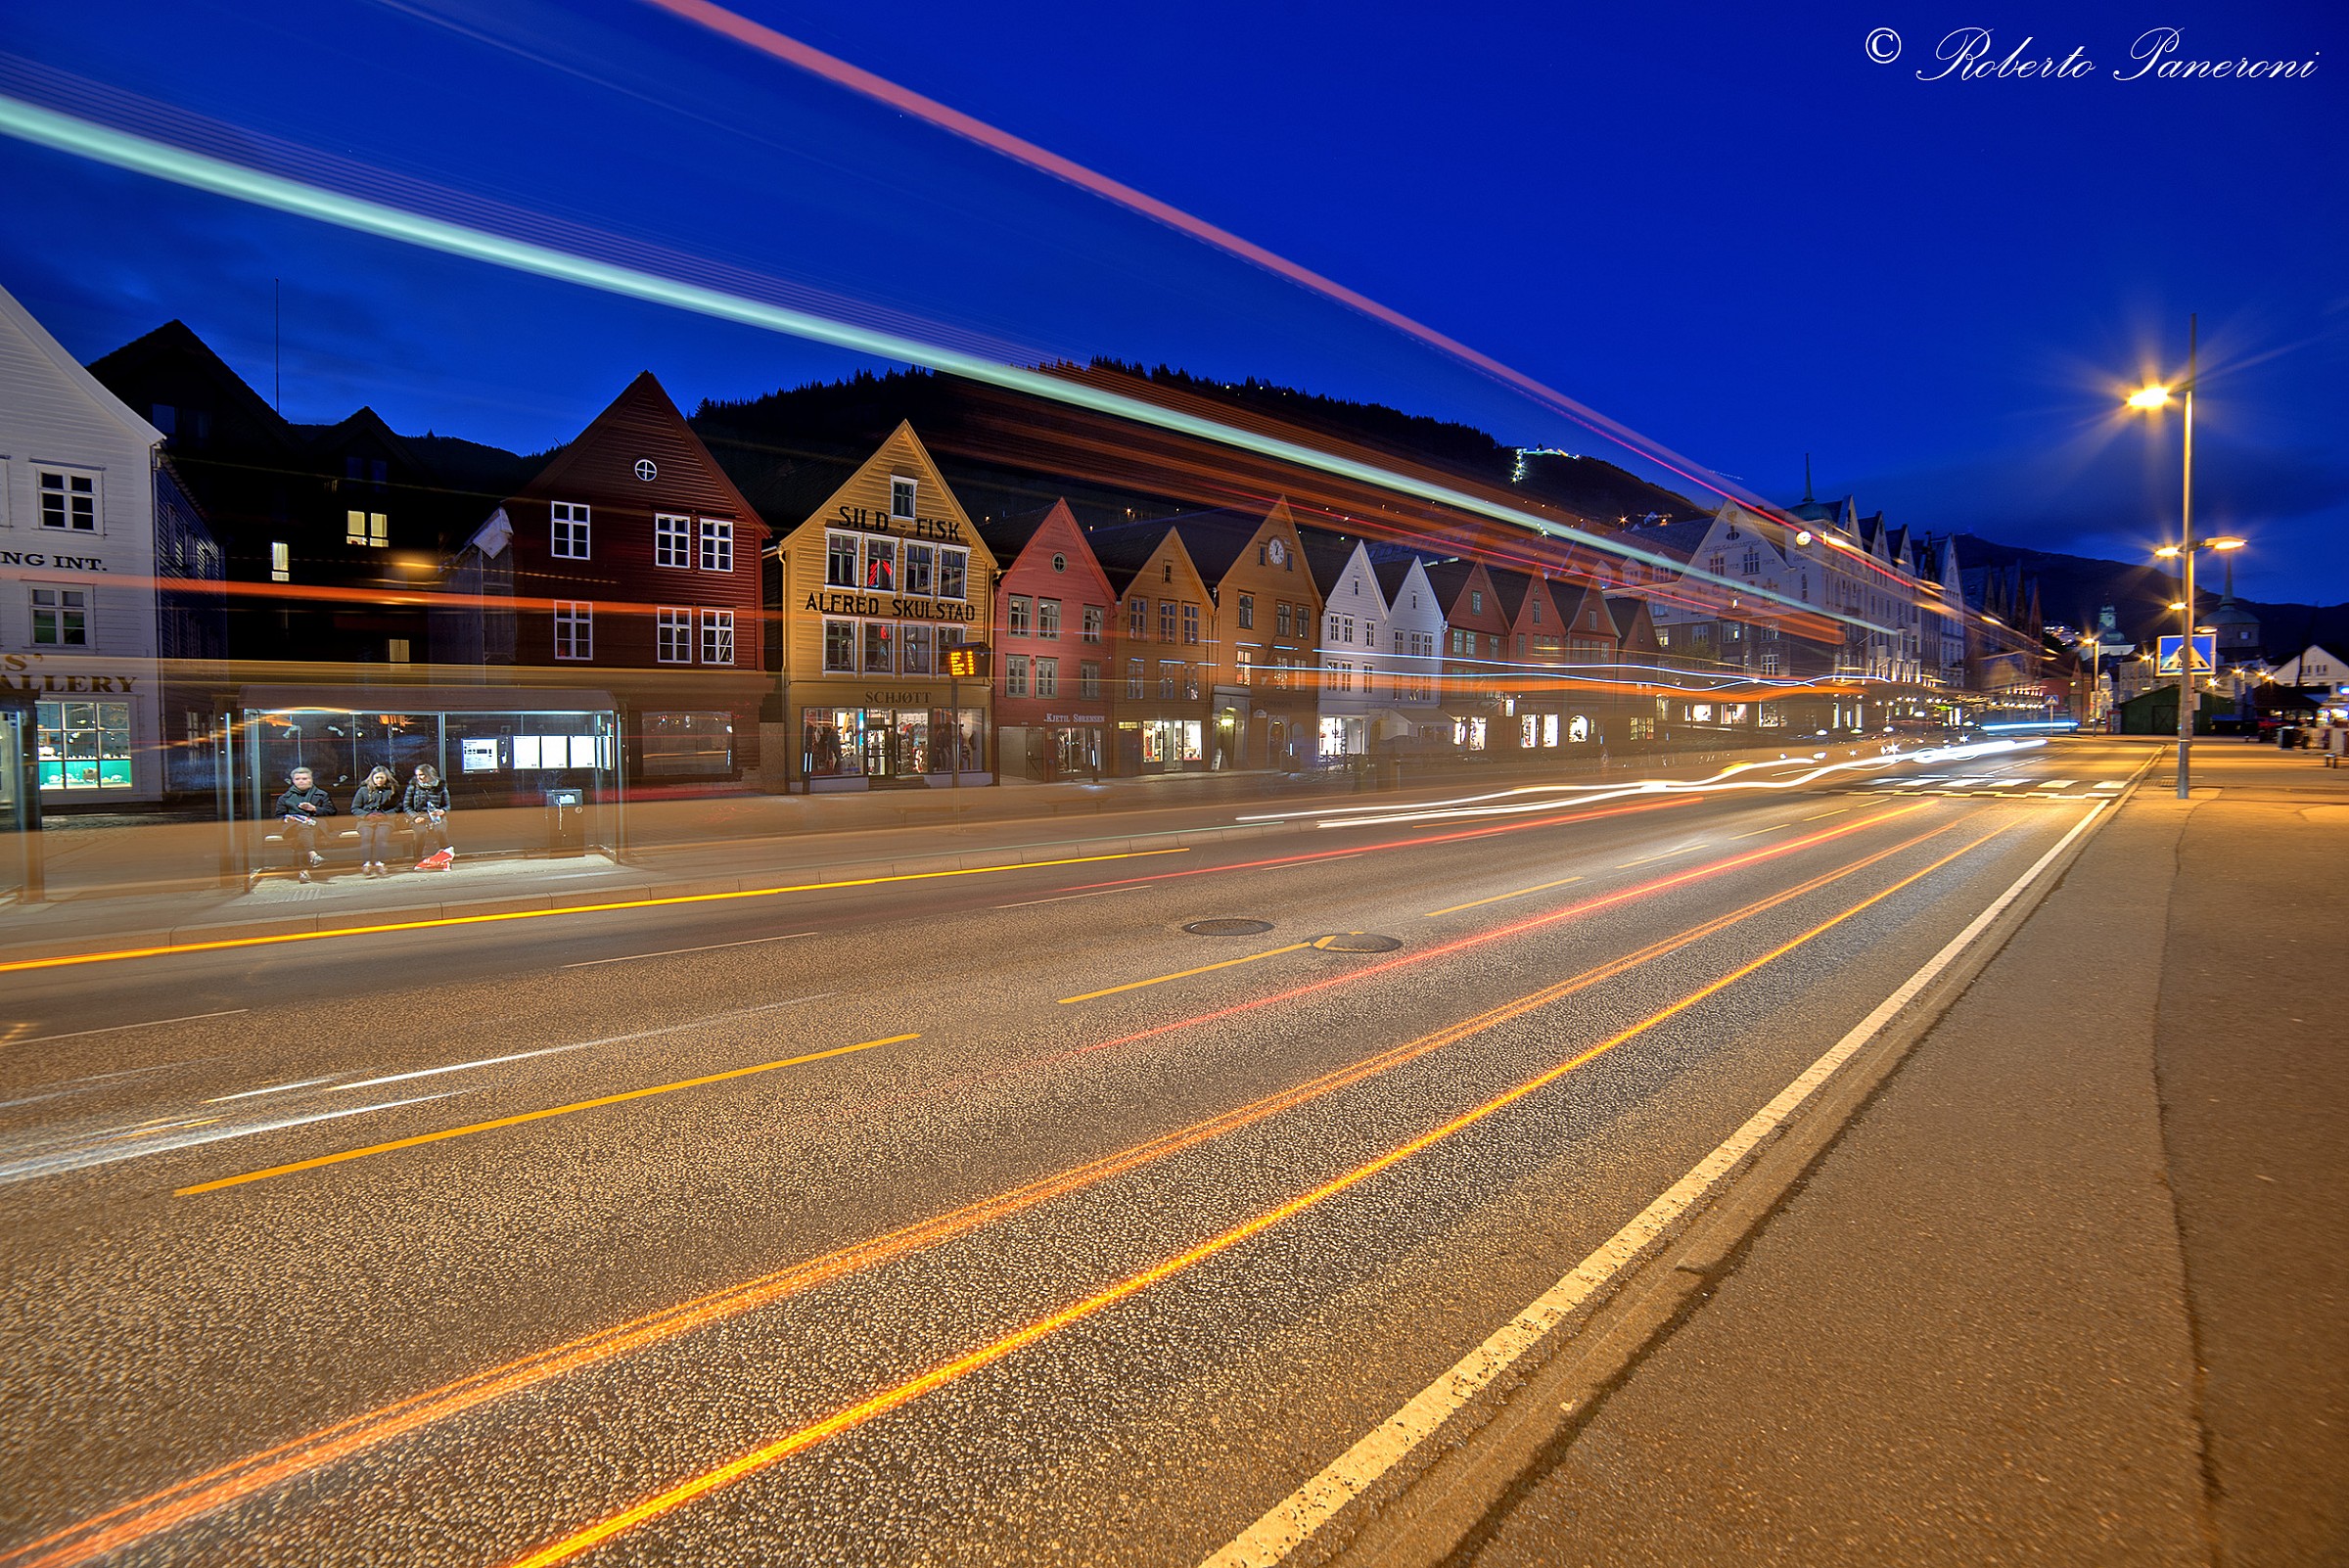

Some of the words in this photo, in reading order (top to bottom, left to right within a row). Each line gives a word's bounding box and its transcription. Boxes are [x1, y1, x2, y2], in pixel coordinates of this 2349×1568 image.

[838, 505, 889, 532] SILD
[916, 518, 961, 541] FISK
[0, 551, 45, 567] NG
[53, 555, 108, 572] INT.
[805, 591, 879, 616] ALFRED
[892, 598, 976, 622] SKULSTAD
[865, 691, 932, 704] SCHJØTT
